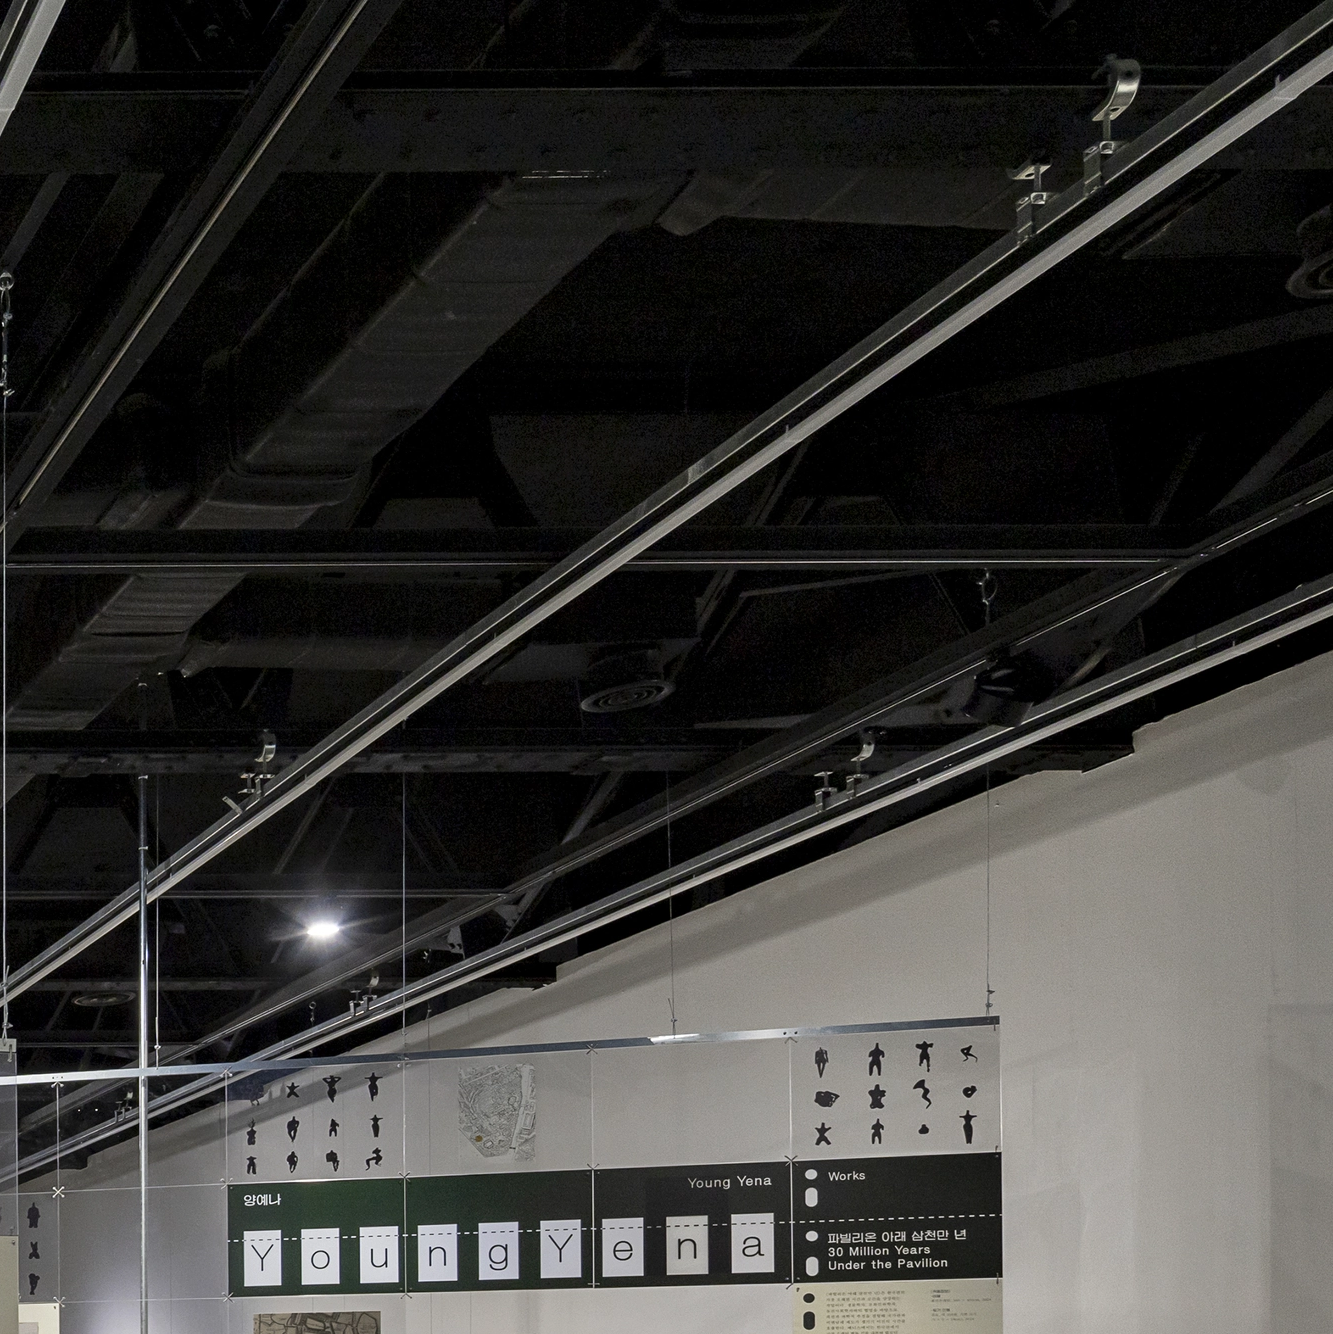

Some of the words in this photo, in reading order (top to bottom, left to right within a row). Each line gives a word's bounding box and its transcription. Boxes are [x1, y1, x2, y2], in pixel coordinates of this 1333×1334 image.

[829, 1171, 865, 1181] Works
[688, 1178, 730, 1189] Young
[737, 1176, 771, 1186] Yena
[244, 1194, 281, 1206] 양예나
[828, 1233, 876, 1243] 파빌리온
[882, 1232, 905, 1242] 아래
[912, 1230, 948, 1241] 삼천만
[955, 1230, 966, 1239] 년
[829, 1247, 843, 1256] 30
[850, 1247, 889, 1256] Million
[895, 1246, 930, 1254] Years
[829, 1261, 865, 1270] Under
[872, 1260, 891, 1269] the
[898, 1258, 947, 1268] Pavilion
